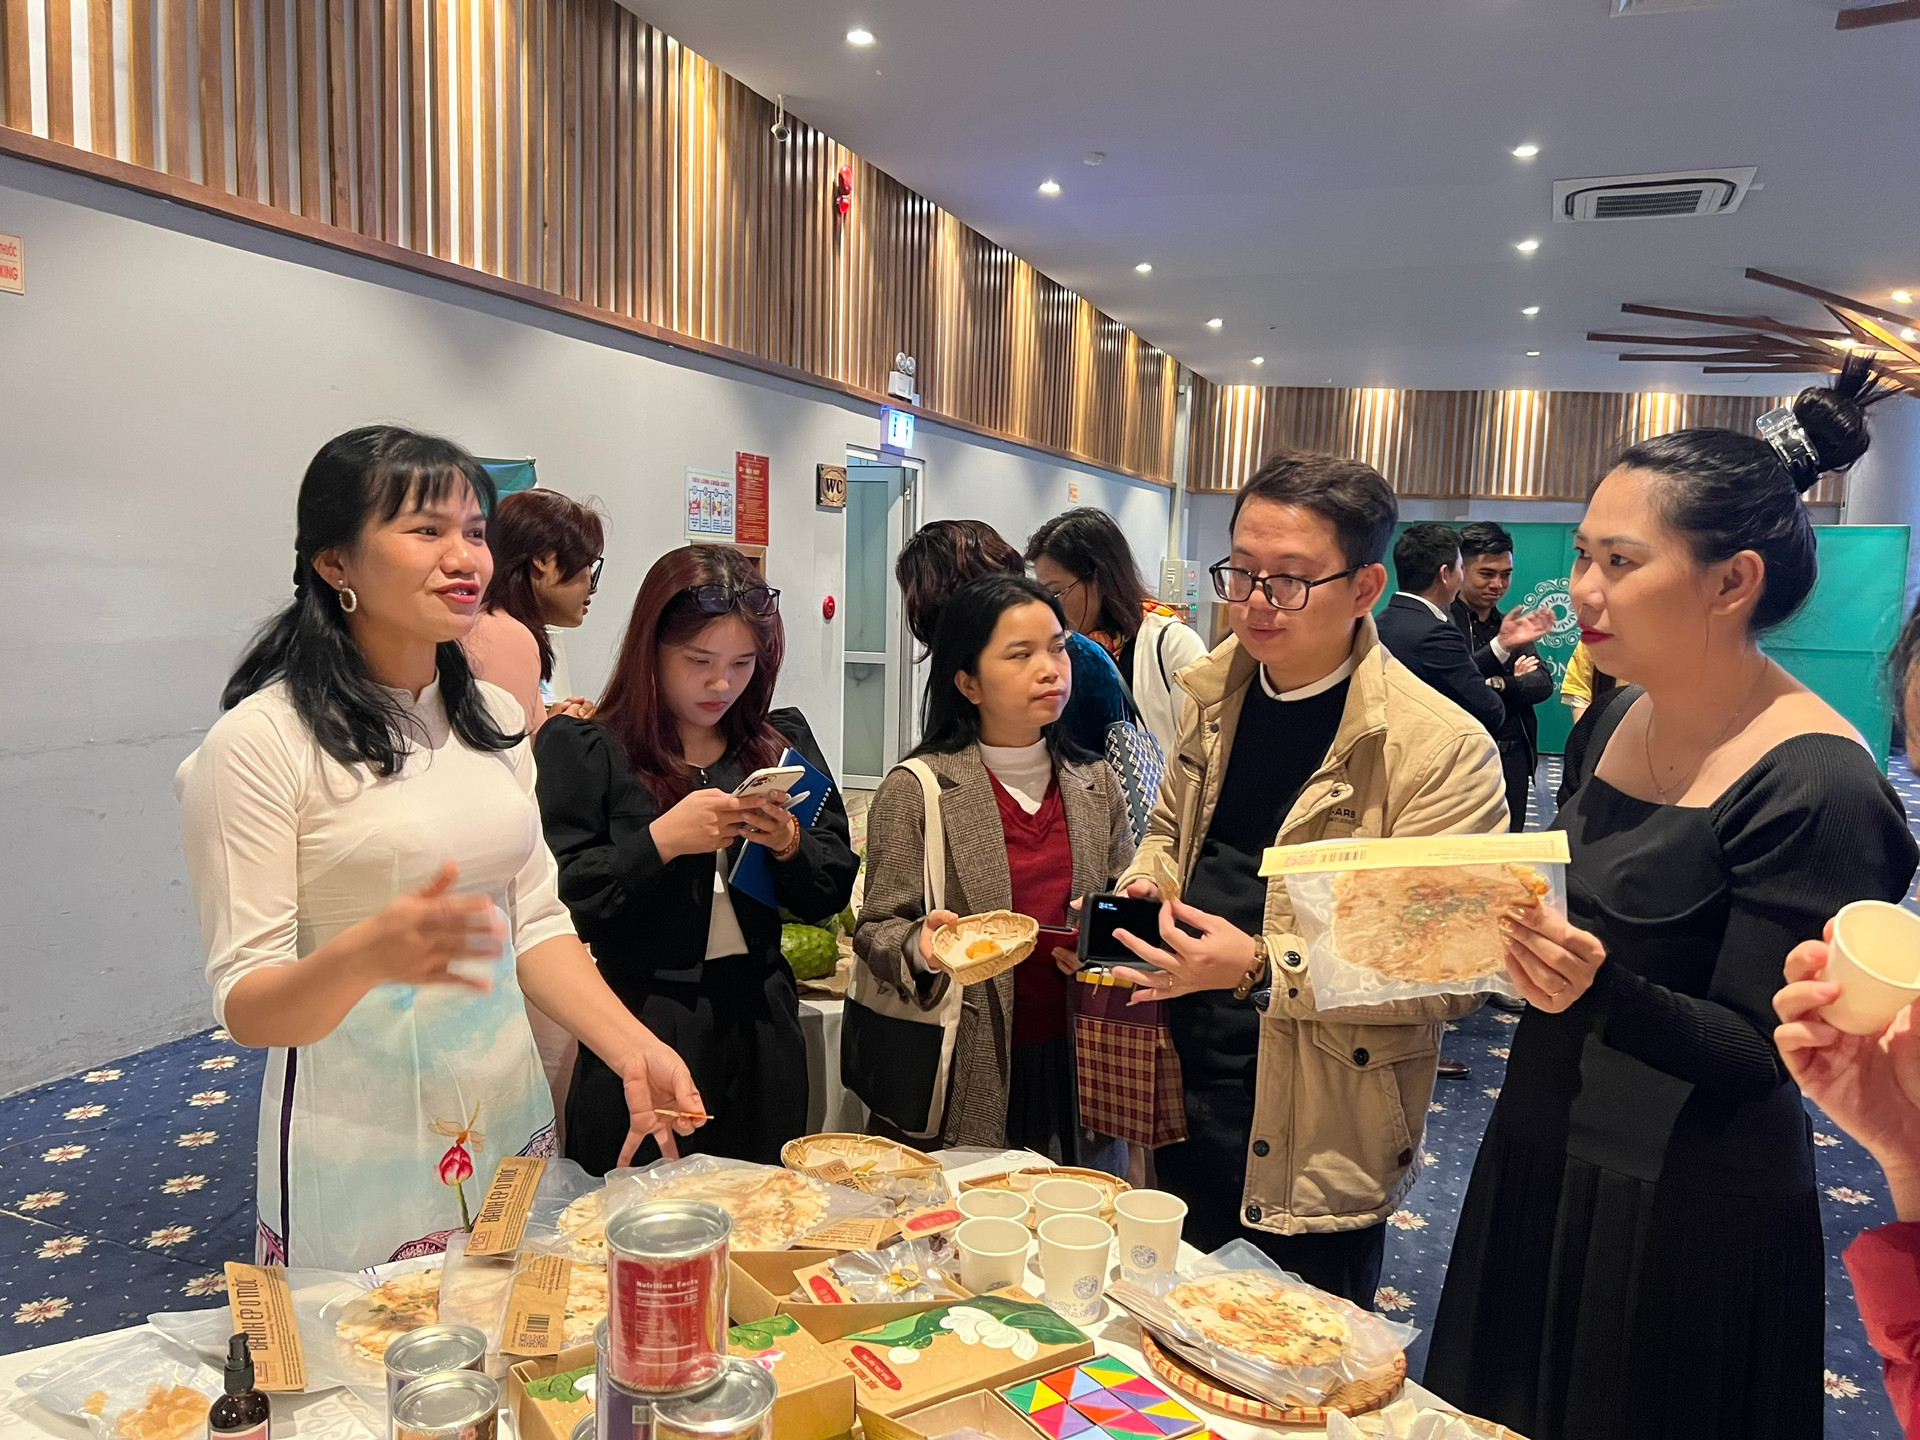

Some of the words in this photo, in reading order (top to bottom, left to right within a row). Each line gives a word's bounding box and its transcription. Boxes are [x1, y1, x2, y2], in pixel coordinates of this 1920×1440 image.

[826, 477, 843, 494] WC
[636, 1280, 673, 1290] Nutrition
[677, 1279, 699, 1289] Facts
